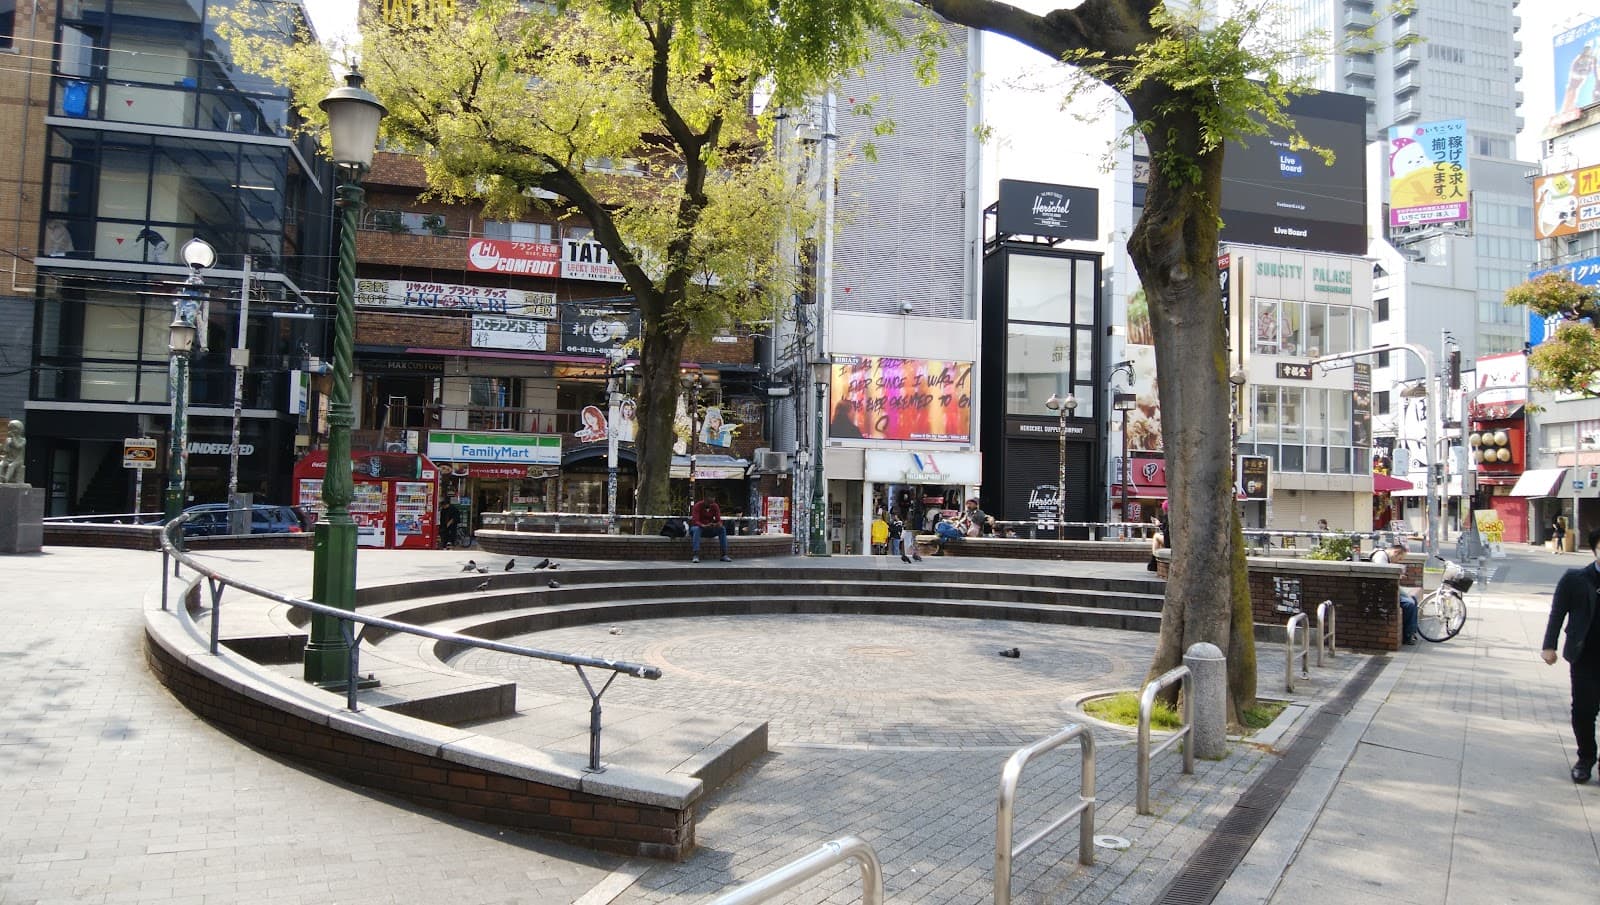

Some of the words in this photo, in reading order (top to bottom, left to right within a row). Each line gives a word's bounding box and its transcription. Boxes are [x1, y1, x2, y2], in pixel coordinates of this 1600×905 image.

[1280, 156, 1295, 164] Live
[1448, 136, 1463, 198] 稼げる求人
[1280, 164, 1302, 173] Board
[1032, 195, 1070, 215] Herschel
[1274, 227, 1287, 235] Live
[1288, 228, 1307, 237] Board
[497, 258, 556, 275] COMFORT
[1257, 261, 1303, 279] SUNCITY
[1312, 267, 1352, 285] PALACE
[406, 283, 443, 293] リサイクル
[449, 286, 479, 296] ブランド
[484, 289, 507, 299] グッズ
[1020, 425, 1043, 433] HERSCHEL
[1064, 426, 1084, 434] OMPANY
[187, 442, 254, 456] UNDEFEAED
[462, 444, 529, 459] FamilyMart
[1028, 489, 1061, 509] Hersche
